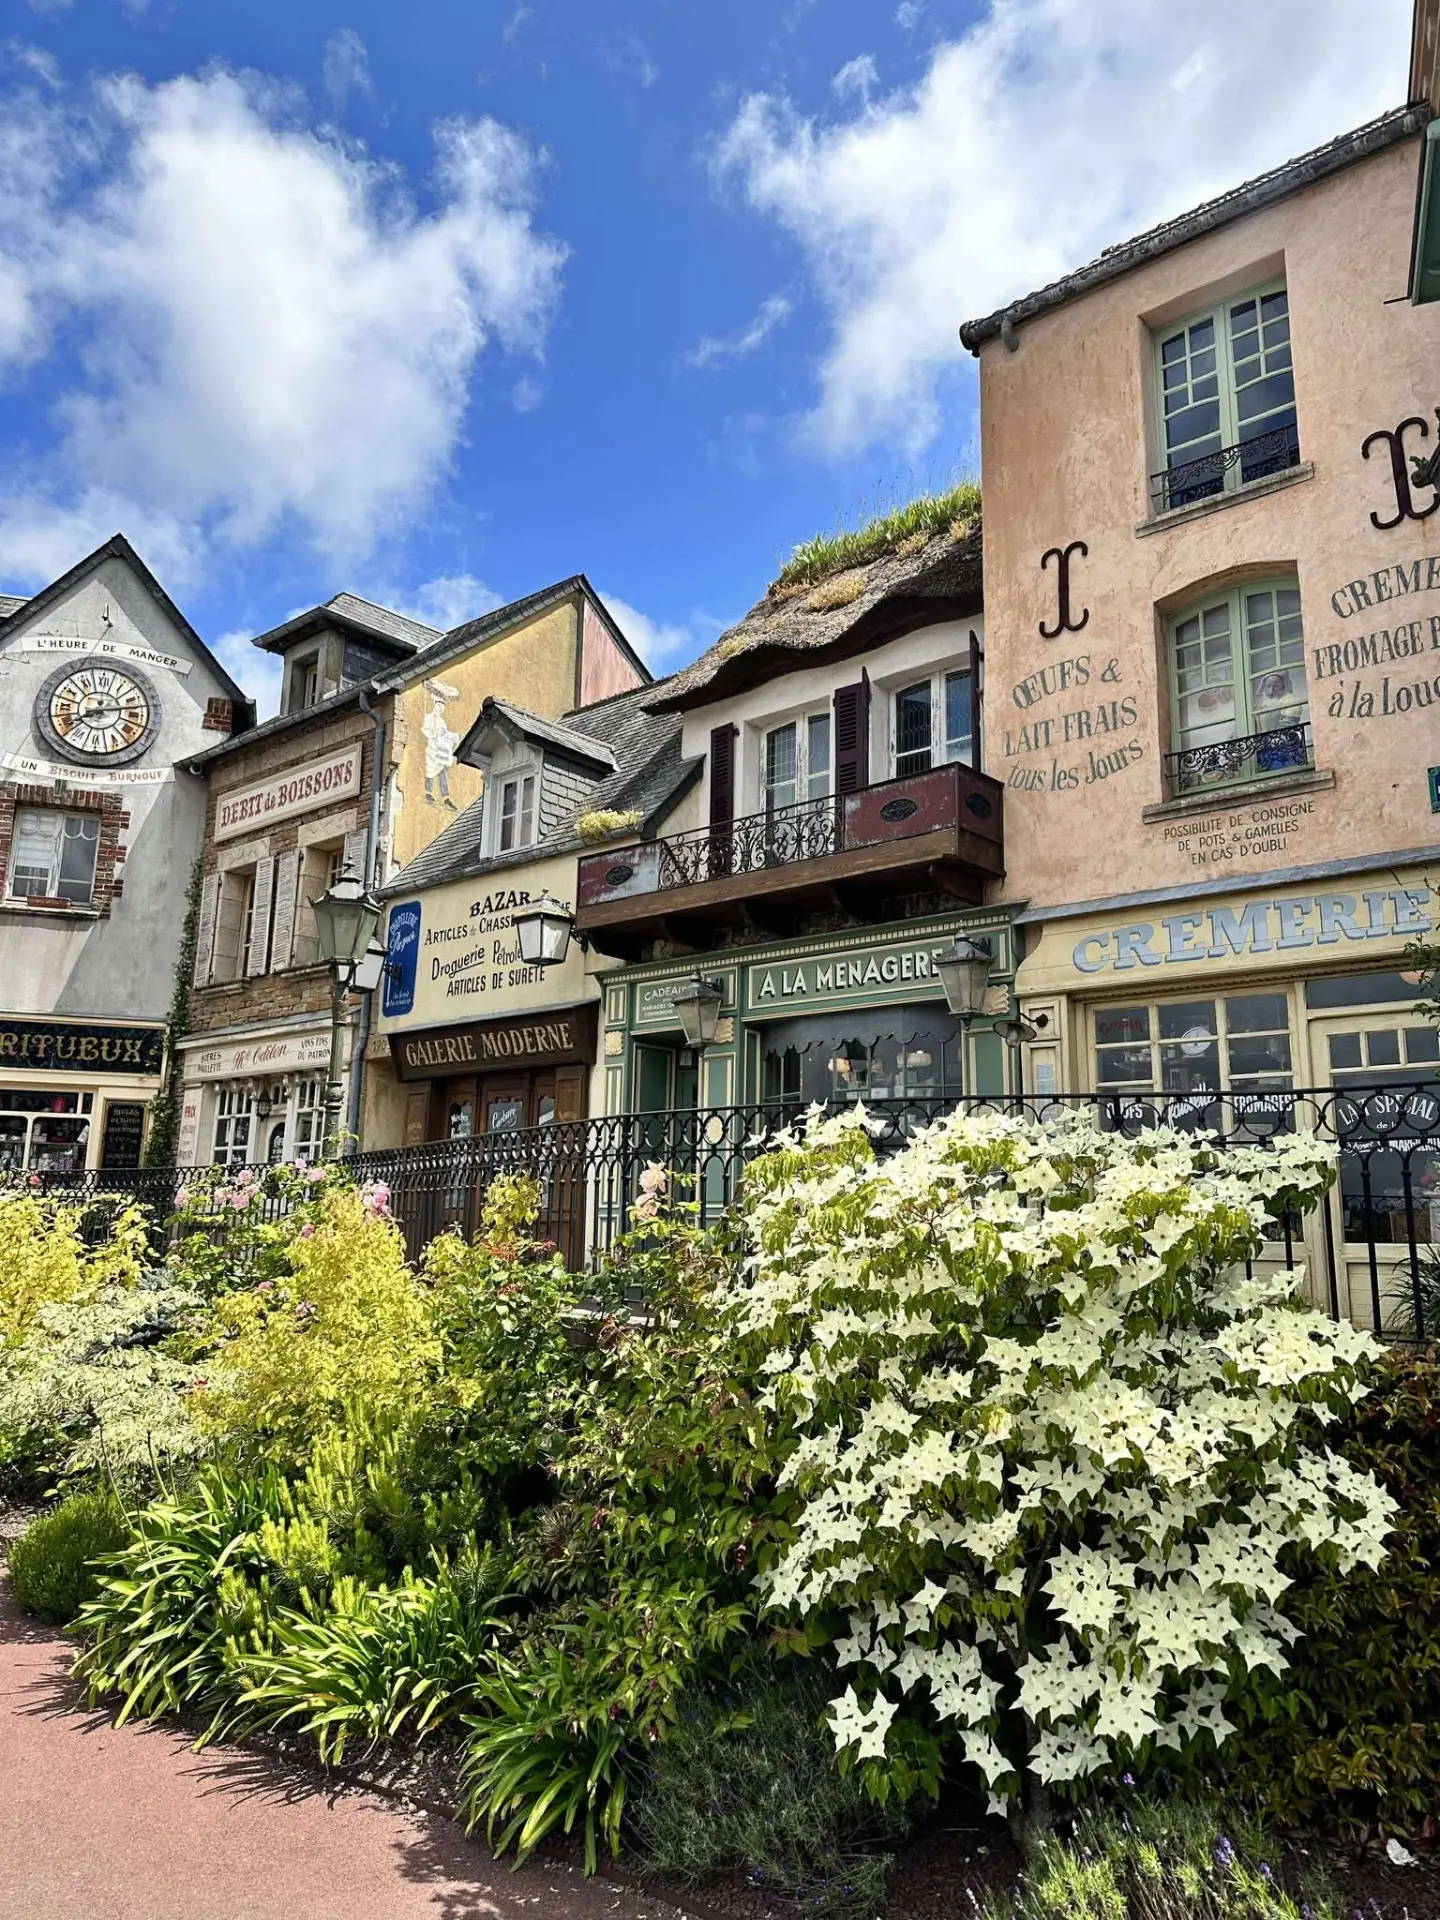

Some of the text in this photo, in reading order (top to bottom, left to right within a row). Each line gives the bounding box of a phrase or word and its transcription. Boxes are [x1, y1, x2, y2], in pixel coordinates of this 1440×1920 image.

[37, 640, 177, 667] L'HEURE DE MANGER
[1313, 620, 1424, 681] FROMAGE
[1012, 655, 1123, 709] ŒUFS &
[1328, 680, 1344, 718] à
[1348, 680, 1375, 719] la
[1004, 696, 1138, 758] LAIT FRAIS
[21, 760, 37, 771] UN
[1007, 739, 1144, 792] tous les Jours
[221, 760, 353, 828] DEBIT de BOISSONS
[1164, 801, 1315, 839] POSSIBILITE DE CONSIGNE
[1178, 819, 1299, 851] DE POTS & GAMELLES
[1192, 838, 1287, 865] EN CAS D'OUBLI
[469, 891, 532, 918] BAZAR
[424, 924, 468, 946] ARTICLES
[1072, 888, 1432, 973] CREMERIE
[432, 945, 485, 981] Droguerie
[758, 949, 943, 999] A LA MENAGERE
[447, 976, 486, 997] ARTICLES
[492, 972, 503, 989] DE
[406, 1023, 573, 1066] GALERIE MODERNE
[1338, 1098, 1370, 1125] LAT
